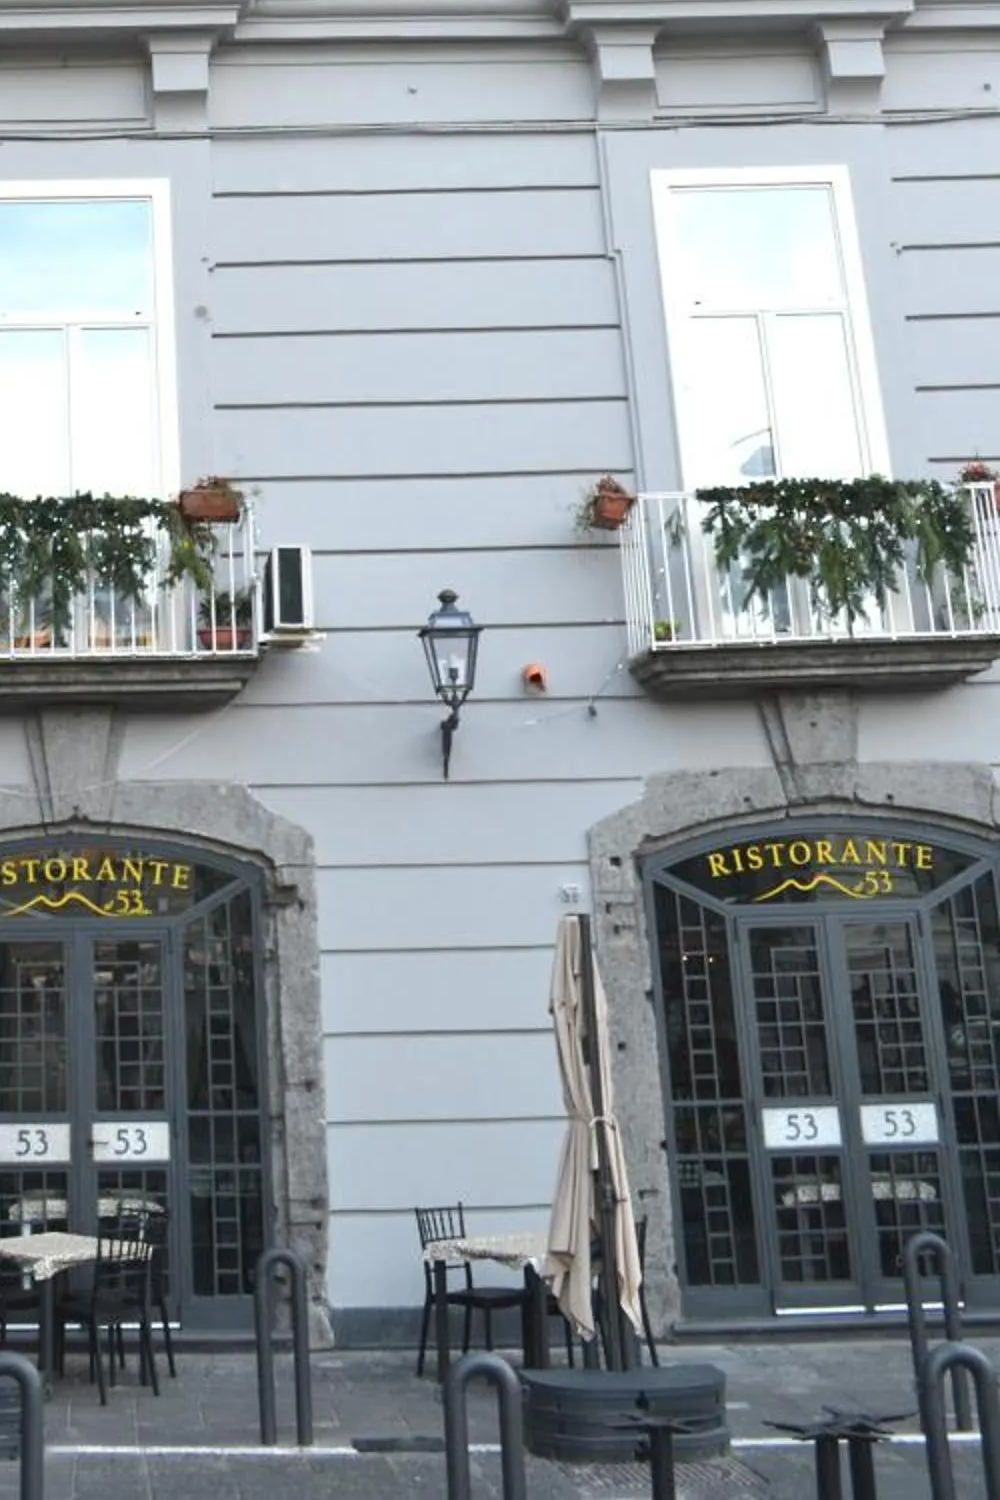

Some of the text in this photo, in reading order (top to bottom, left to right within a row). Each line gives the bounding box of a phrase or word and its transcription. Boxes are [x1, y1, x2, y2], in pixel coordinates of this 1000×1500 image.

[707, 839, 933, 877] RISTORANTE
[864, 871, 893, 896] 53
[116, 889, 144, 914] 53
[786, 1114, 818, 1140] 53
[884, 1110, 915, 1137] 53
[15, 1129, 48, 1156] 53
[114, 1128, 147, 1155] 53
